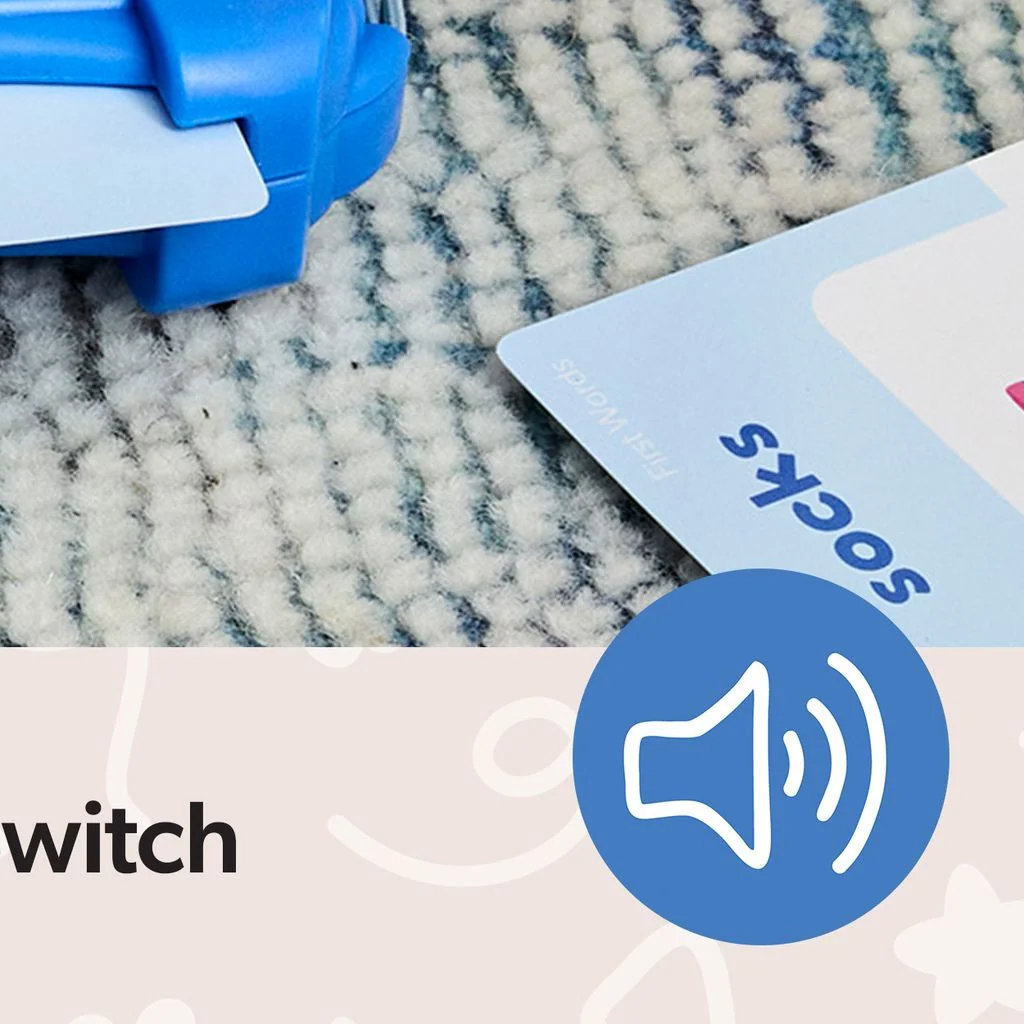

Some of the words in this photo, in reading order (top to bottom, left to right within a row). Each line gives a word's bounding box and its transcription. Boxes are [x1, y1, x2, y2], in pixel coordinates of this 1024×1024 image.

[552, 358, 627, 435] Words
[622, 432, 679, 481] First
[719, 423, 931, 604] socks
